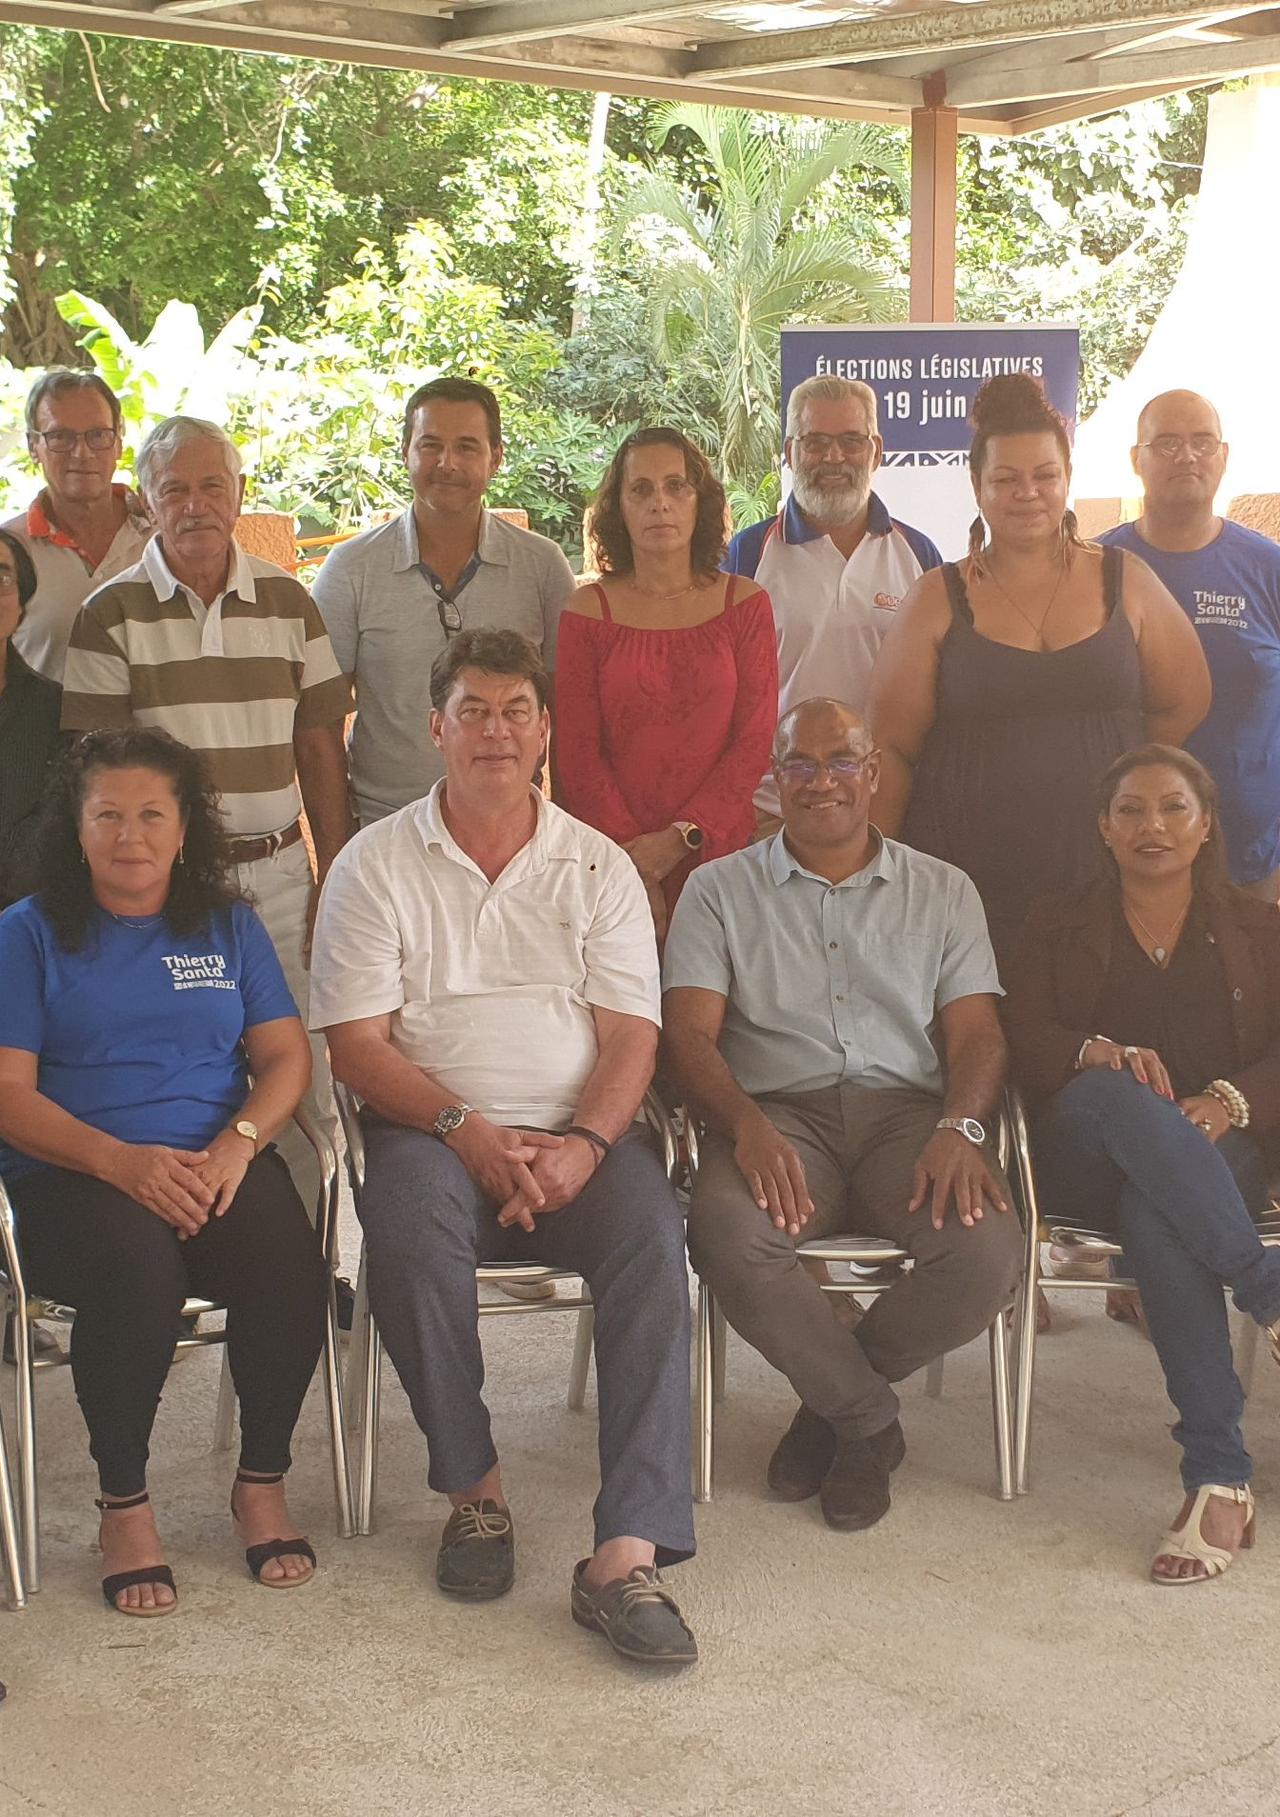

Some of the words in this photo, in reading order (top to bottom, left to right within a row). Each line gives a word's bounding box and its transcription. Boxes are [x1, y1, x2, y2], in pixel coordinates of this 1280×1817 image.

[815, 355, 913, 380] ÉLECTIONS
[920, 353, 1044, 379] LÉGISLATIVES
[883, 391, 911, 419] 19
[919, 389, 967, 426] juin
[1192, 590, 1246, 610] Thierry
[1197, 602, 1240, 617] Santa
[160, 953, 227, 969] Thierry
[171, 966, 225, 981] Santa
